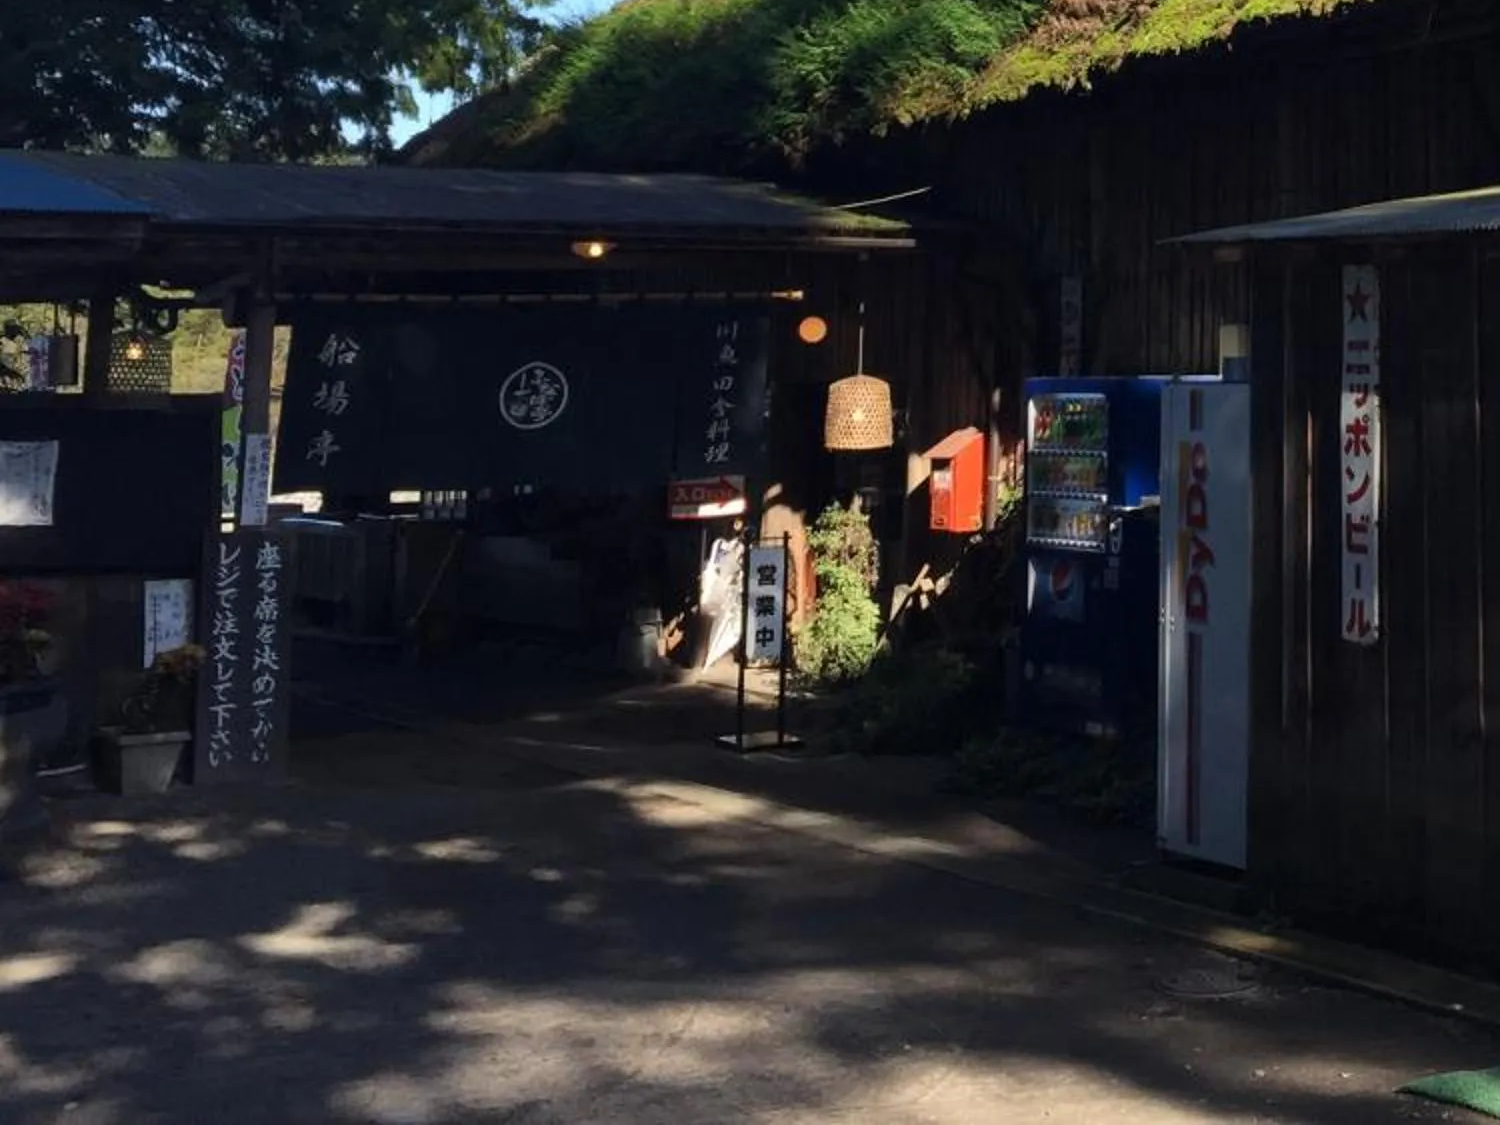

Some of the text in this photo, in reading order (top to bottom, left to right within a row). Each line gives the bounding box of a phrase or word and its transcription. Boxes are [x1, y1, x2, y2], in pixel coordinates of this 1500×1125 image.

[208, 541, 241, 769] レジで注文して下さい
